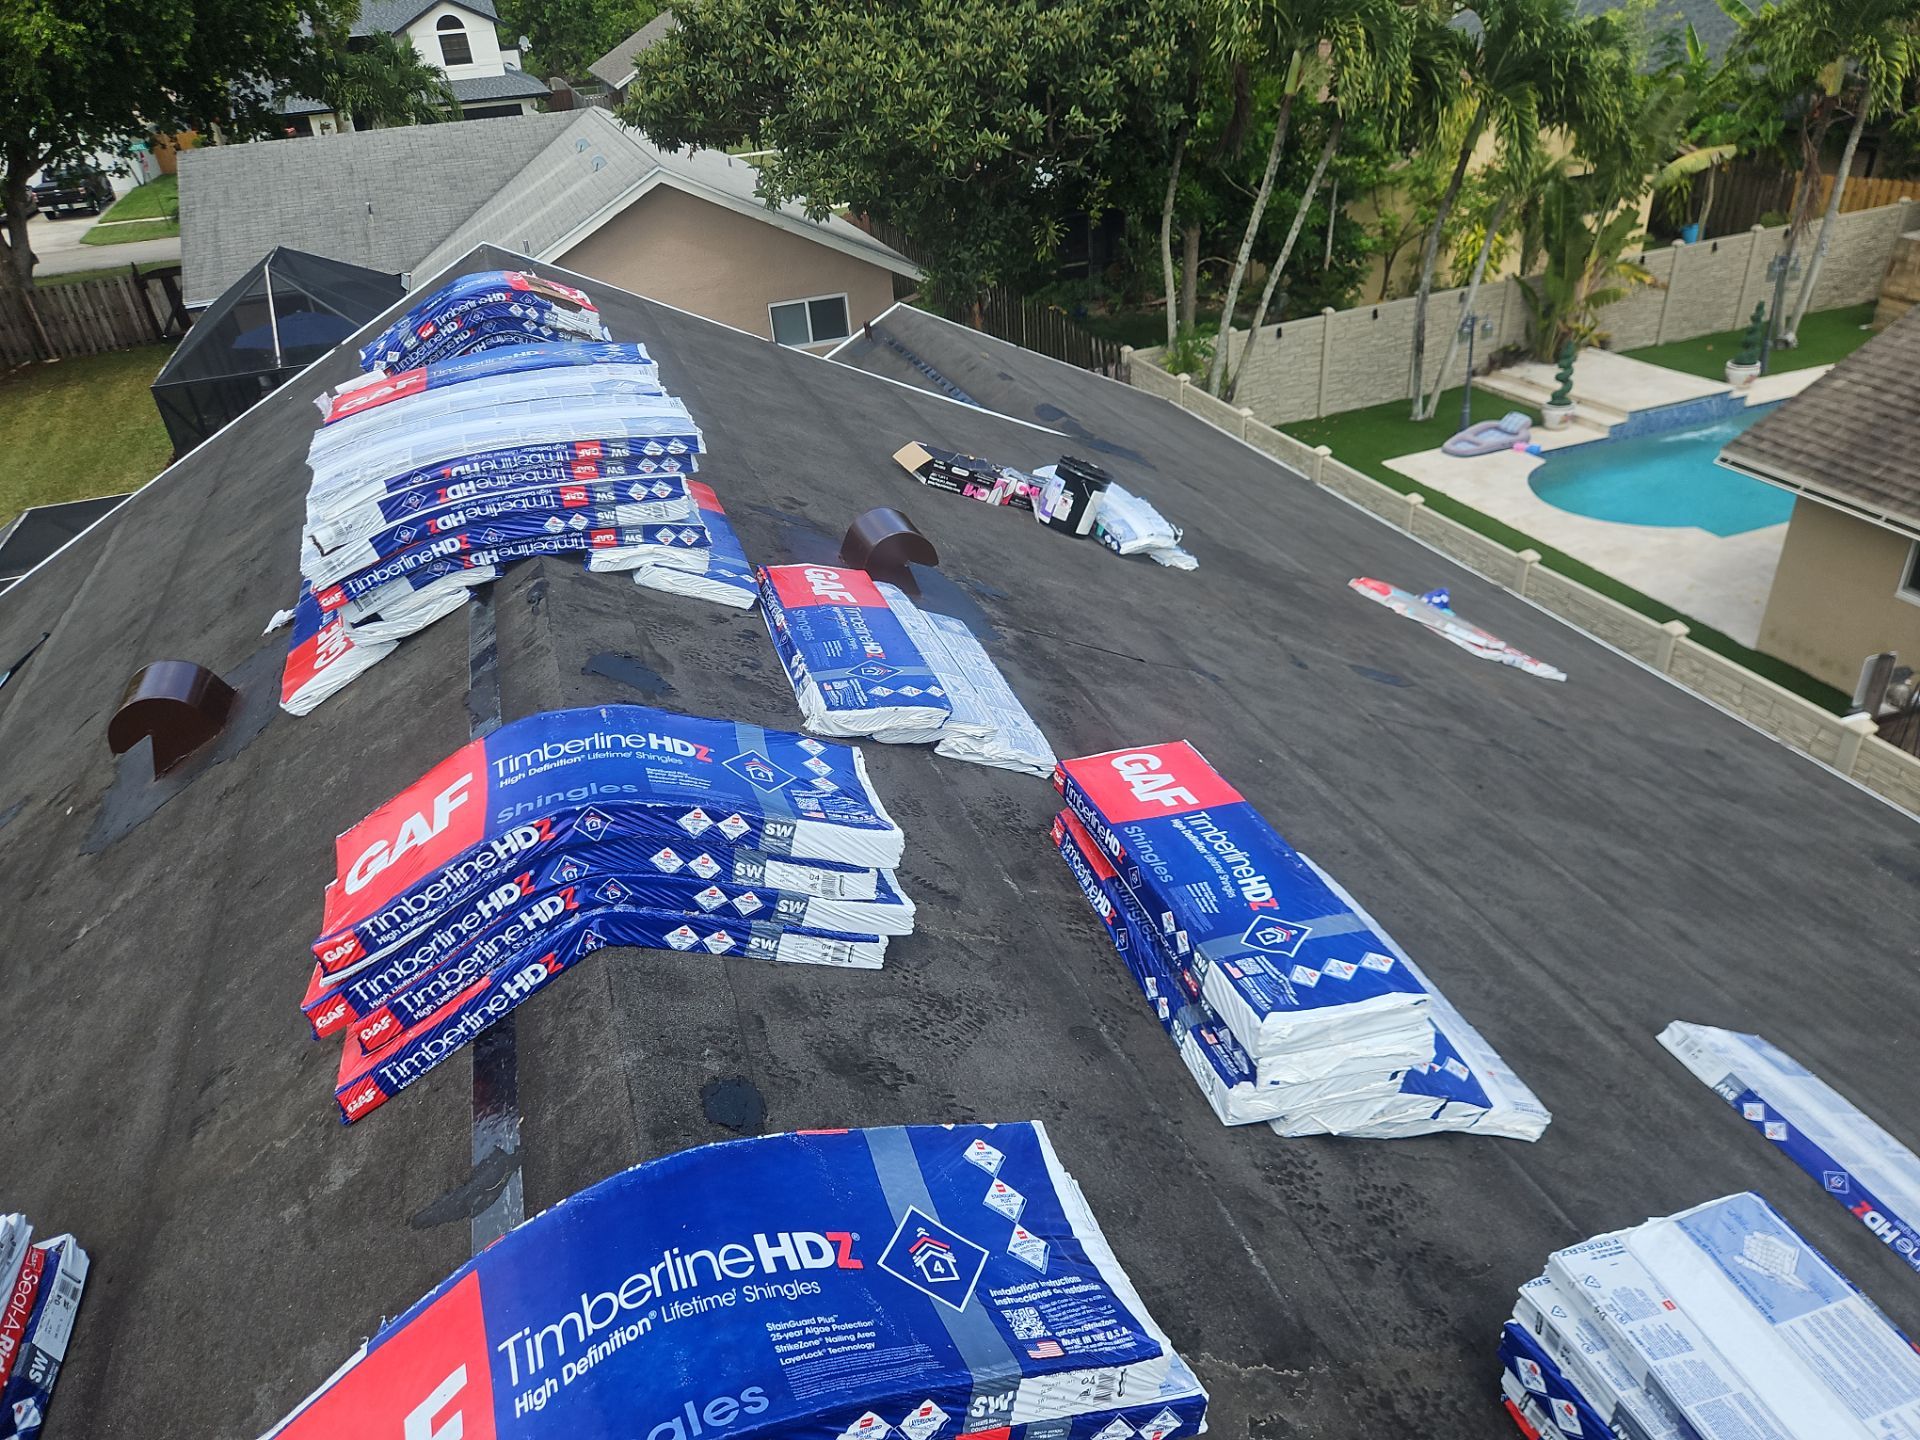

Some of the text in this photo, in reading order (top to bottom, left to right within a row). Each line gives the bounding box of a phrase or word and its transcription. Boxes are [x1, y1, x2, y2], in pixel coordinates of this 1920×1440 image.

[578, 447, 600, 457] GAF
[804, 568, 858, 604] GAF
[320, 591, 342, 606] GAF
[492, 732, 714, 778] TimberlineHDZ
[499, 772, 526, 788] High
[635, 751, 684, 766] Shingles
[1111, 752, 1200, 807] GAF
[496, 782, 639, 825] Shingles
[344, 772, 473, 896] GAF
[764, 822, 793, 838] SW
[1170, 818, 1184, 832] High
[1124, 825, 1174, 884] Shingles
[1185, 811, 1280, 911] TimberlineHDZ
[734, 862, 764, 878] SW
[777, 900, 806, 914] SW
[376, 929, 398, 945] High
[749, 937, 779, 951] SW
[324, 940, 356, 963] GAF
[368, 992, 390, 1009] High
[315, 1004, 348, 1029] GAF
[413, 1004, 434, 1020] High
[360, 1015, 392, 1041] GAF
[1714, 1083, 1739, 1101] SW
[346, 1089, 377, 1115] GAF
[989, 1282, 1040, 1297] Installation
[994, 1290, 1052, 1306] Instrucciones
[766, 1317, 816, 1332] StainGuard
[770, 1330, 803, 1342] 25-year
[805, 1326, 831, 1335] Algae
[825, 1333, 856, 1343] Nailing
[857, 1331, 876, 1339] Area
[1082, 1335, 1092, 1344] IN
[1106, 1326, 1132, 1340] U.S.A.
[514, 1377, 558, 1419] High
[743, 1279, 821, 1303] Shingles
[827, 1342, 875, 1355] Technology
[29, 1350, 49, 1383] SW
[971, 1391, 1014, 1418] SW
